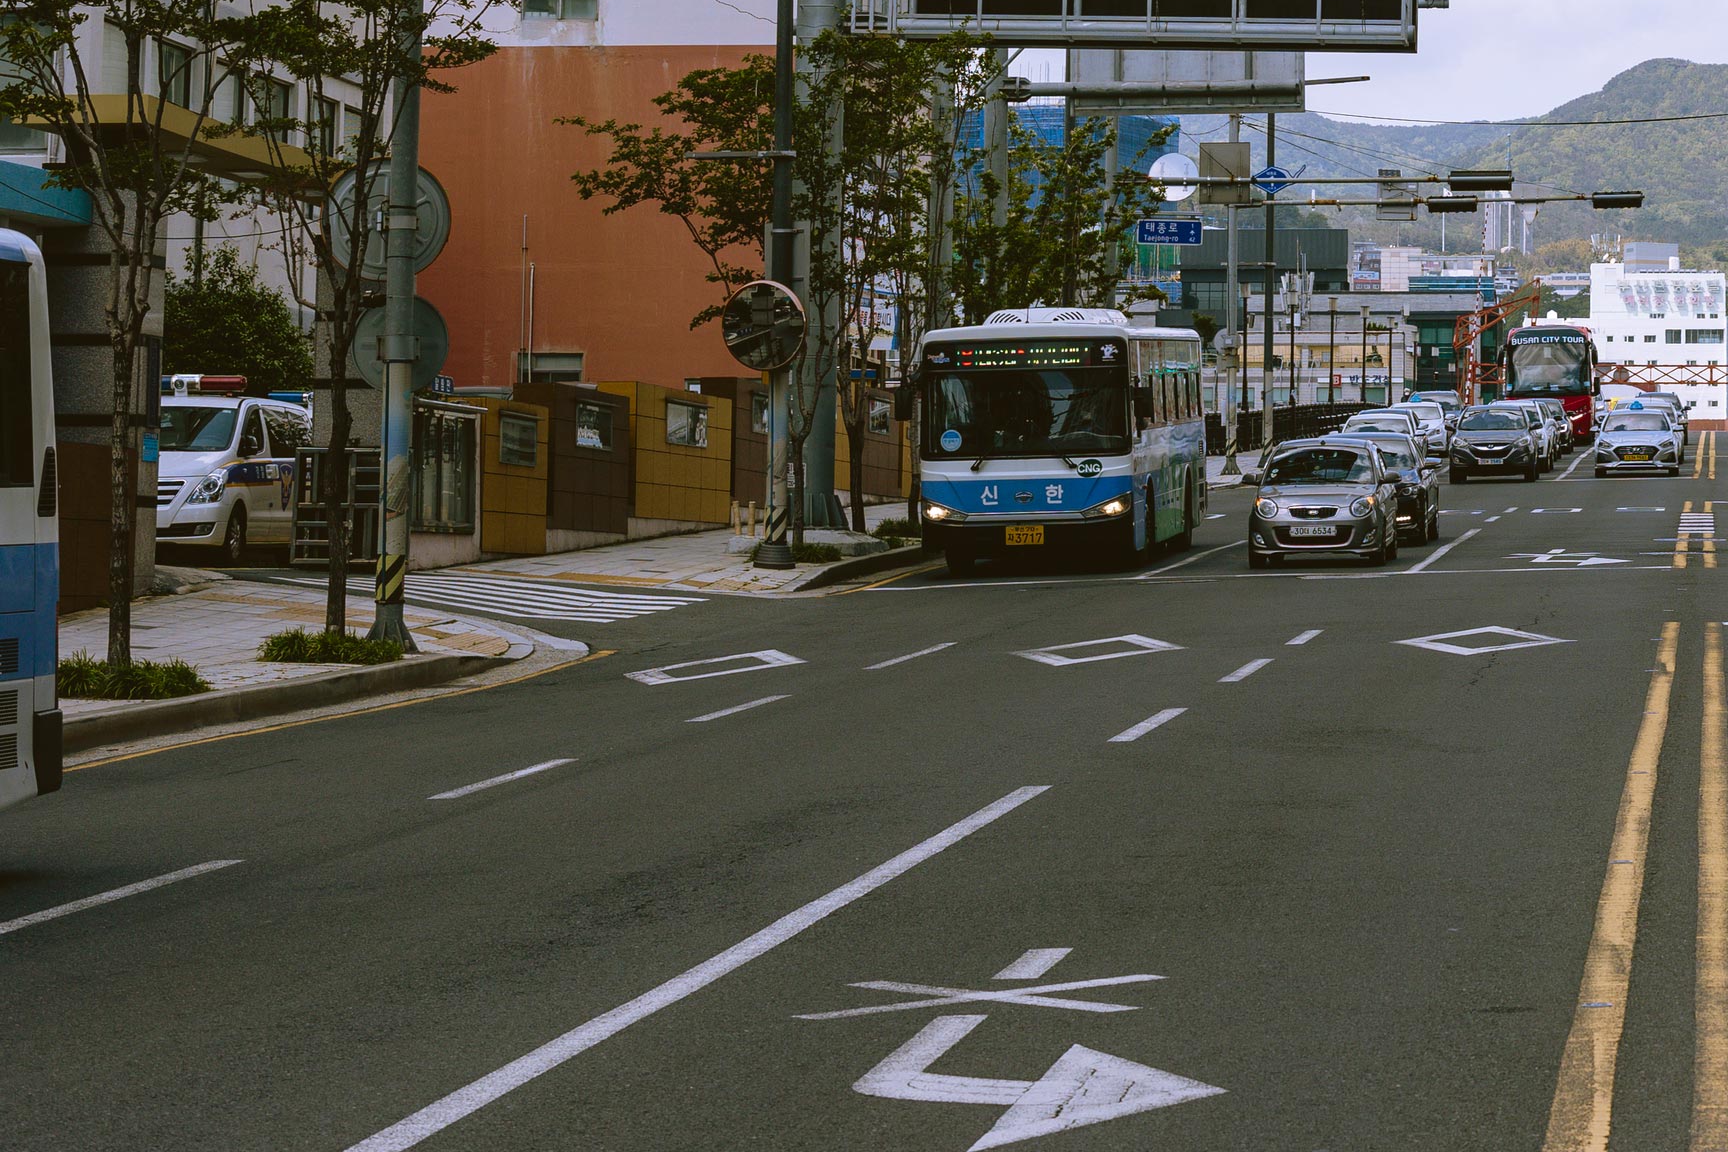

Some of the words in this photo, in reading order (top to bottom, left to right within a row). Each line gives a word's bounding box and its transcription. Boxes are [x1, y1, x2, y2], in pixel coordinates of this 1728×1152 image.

[1145, 222, 1178, 234] 태종로
[1144, 234, 1179, 243] Taejong-ro
[1511, 336, 1540, 346] BUSAN
[1541, 335, 1560, 344] CITY
[1562, 336, 1585, 344] TOUR
[1077, 464, 1101, 473] CNG
